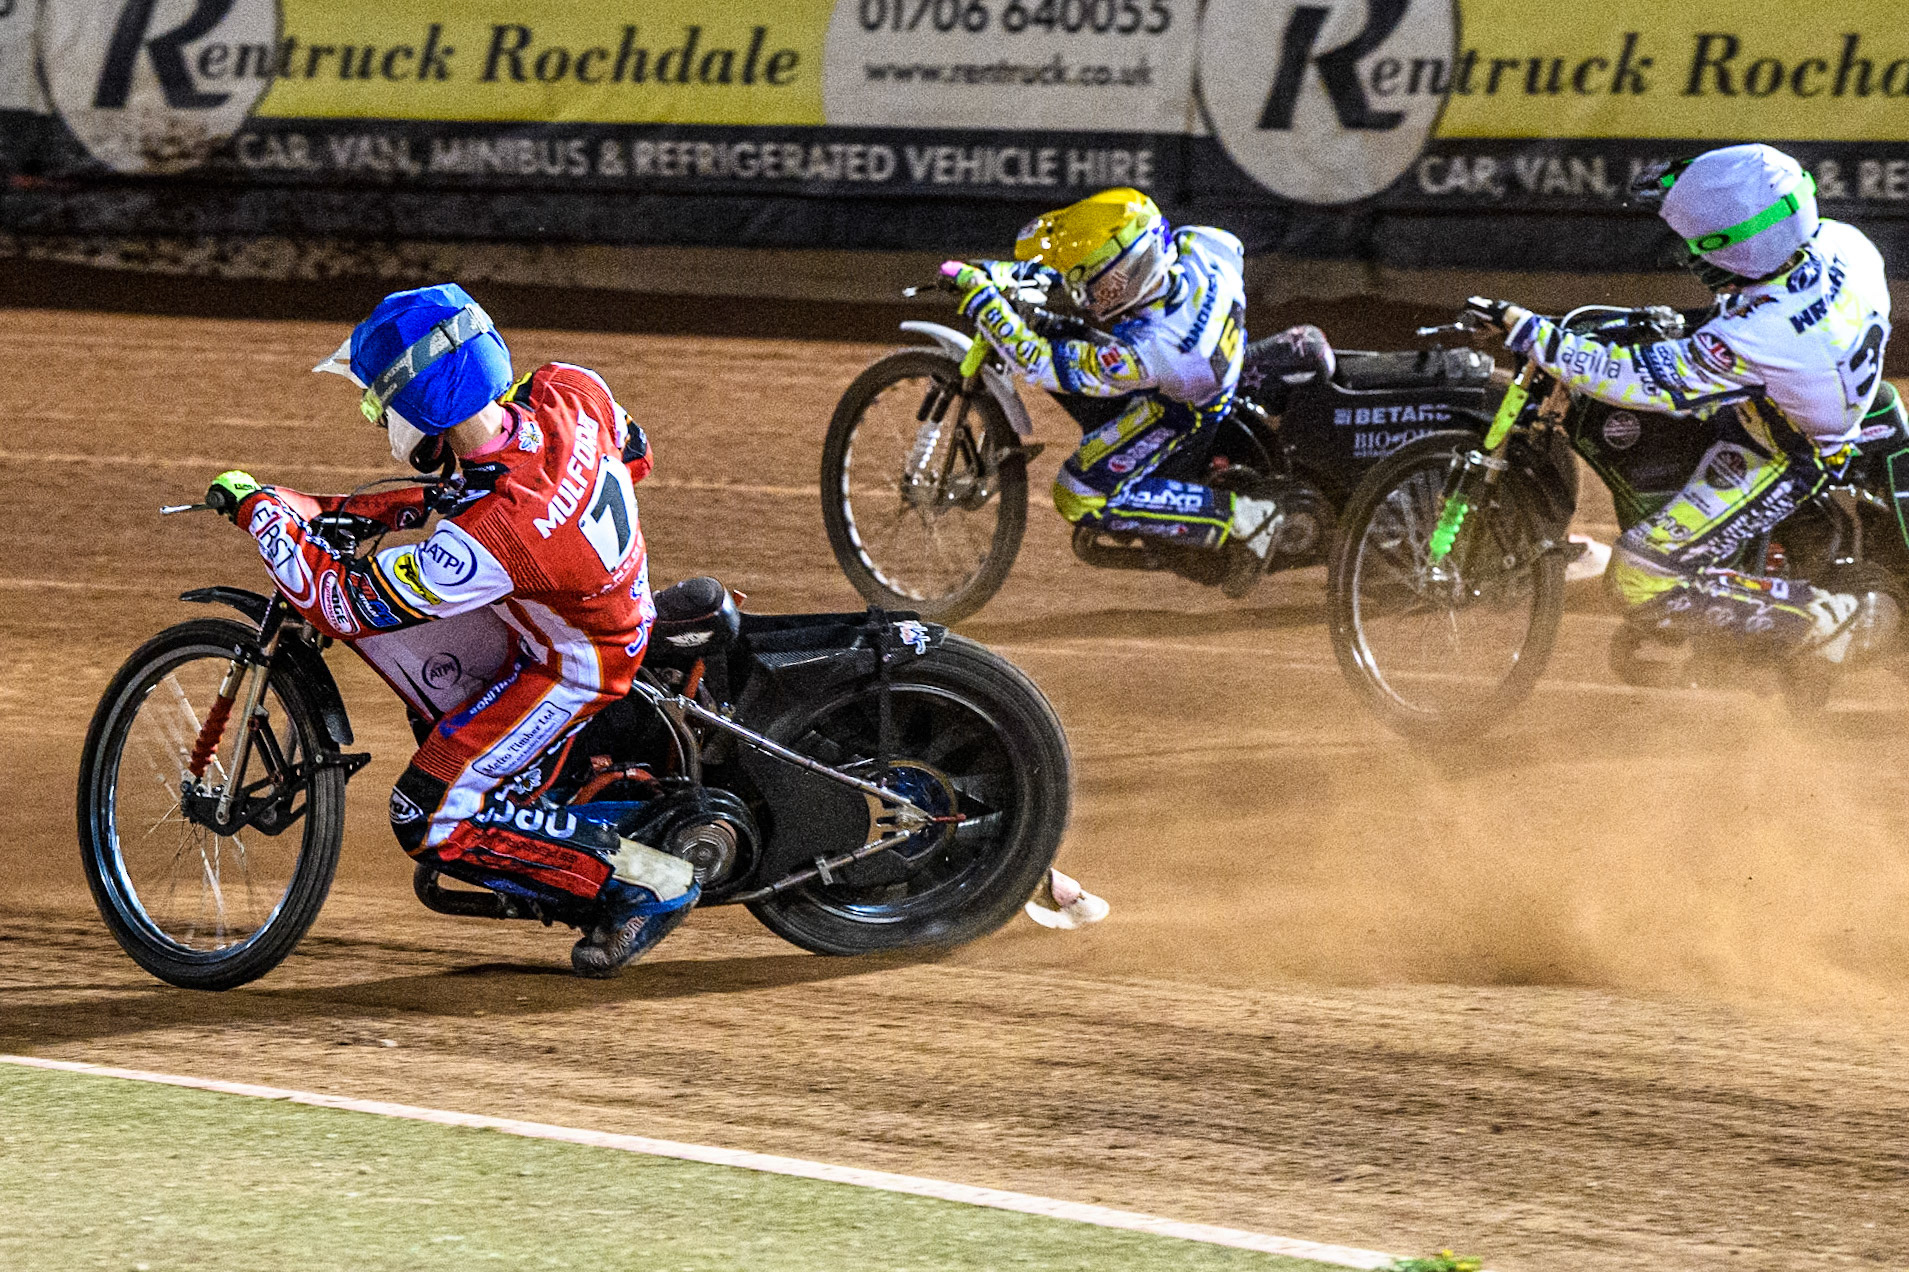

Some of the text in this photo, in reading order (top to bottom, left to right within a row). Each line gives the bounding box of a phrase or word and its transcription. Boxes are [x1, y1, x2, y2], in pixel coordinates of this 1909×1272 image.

[478, 23, 799, 87] Rochdale
[864, 52, 1153, 87] www.rentruck.co.uk
[1256, 2, 1654, 132] Rentruck
[430, 137, 589, 177] MINIBUS
[601, 140, 627, 177] &
[634, 140, 896, 183] REFRIGERATED
[904, 145, 1059, 187] VEHICLE
[1067, 150, 1153, 188] HIRE
[1817, 160, 1845, 199] &
[532, 407, 600, 540] MULFORD
[425, 541, 466, 576] ATPI
[428, 660, 457, 682] ATPI
[482, 707, 556, 776] Metro Timber Ltd
